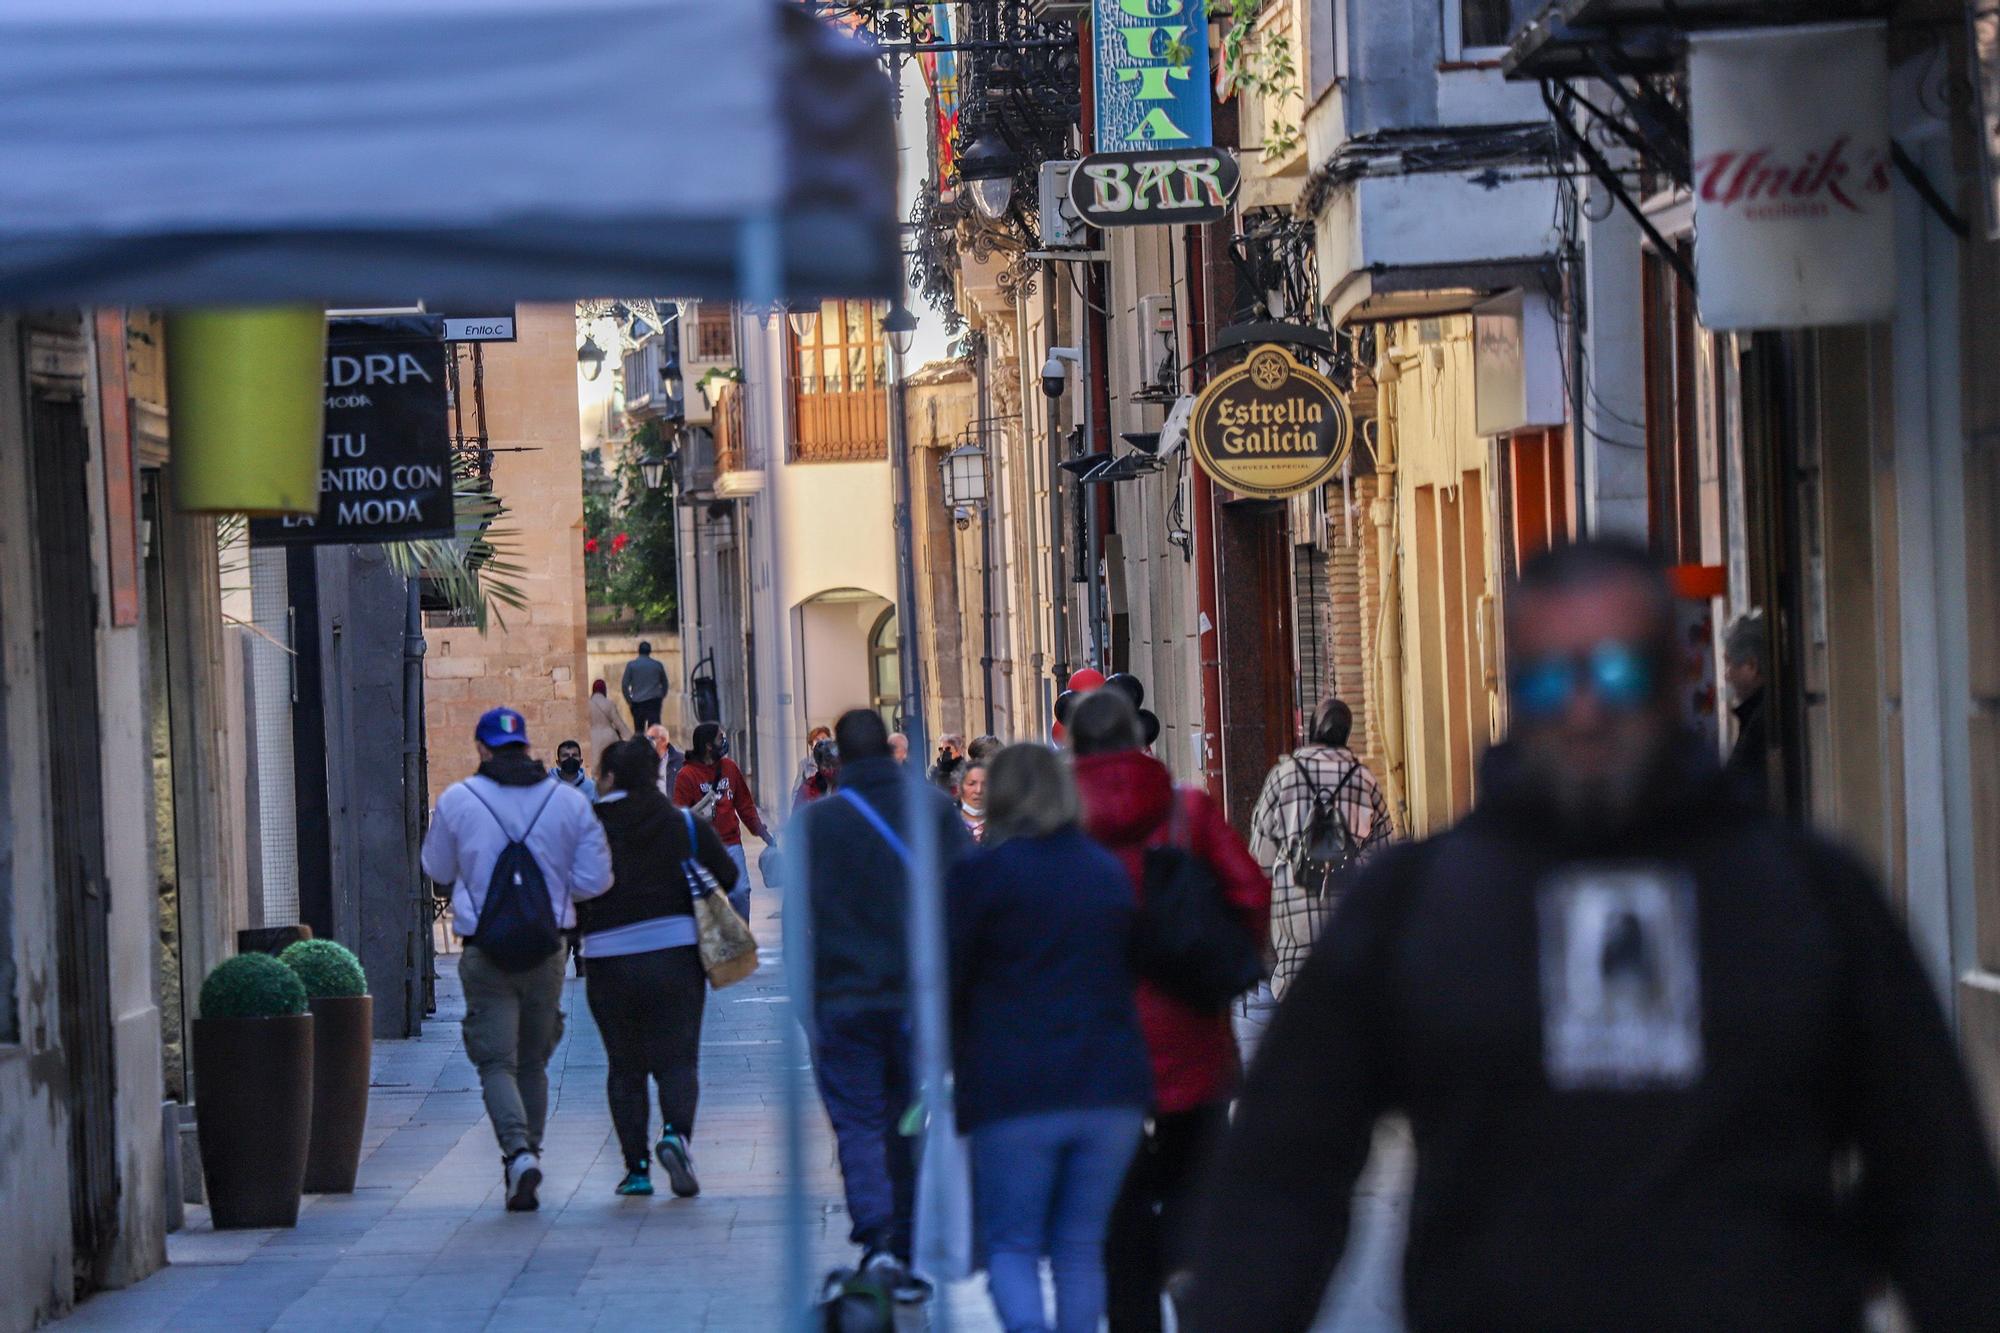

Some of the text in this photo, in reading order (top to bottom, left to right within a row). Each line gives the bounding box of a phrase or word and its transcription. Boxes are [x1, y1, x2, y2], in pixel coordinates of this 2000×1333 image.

[1084, 158, 1230, 213] BAR
[324, 353, 432, 387] DRA
[1217, 398, 1323, 425] Estrella
[327, 433, 367, 458] TU
[1222, 425, 1318, 454] Galicia
[393, 464, 442, 489] CON
[338, 498, 423, 525] MODA
